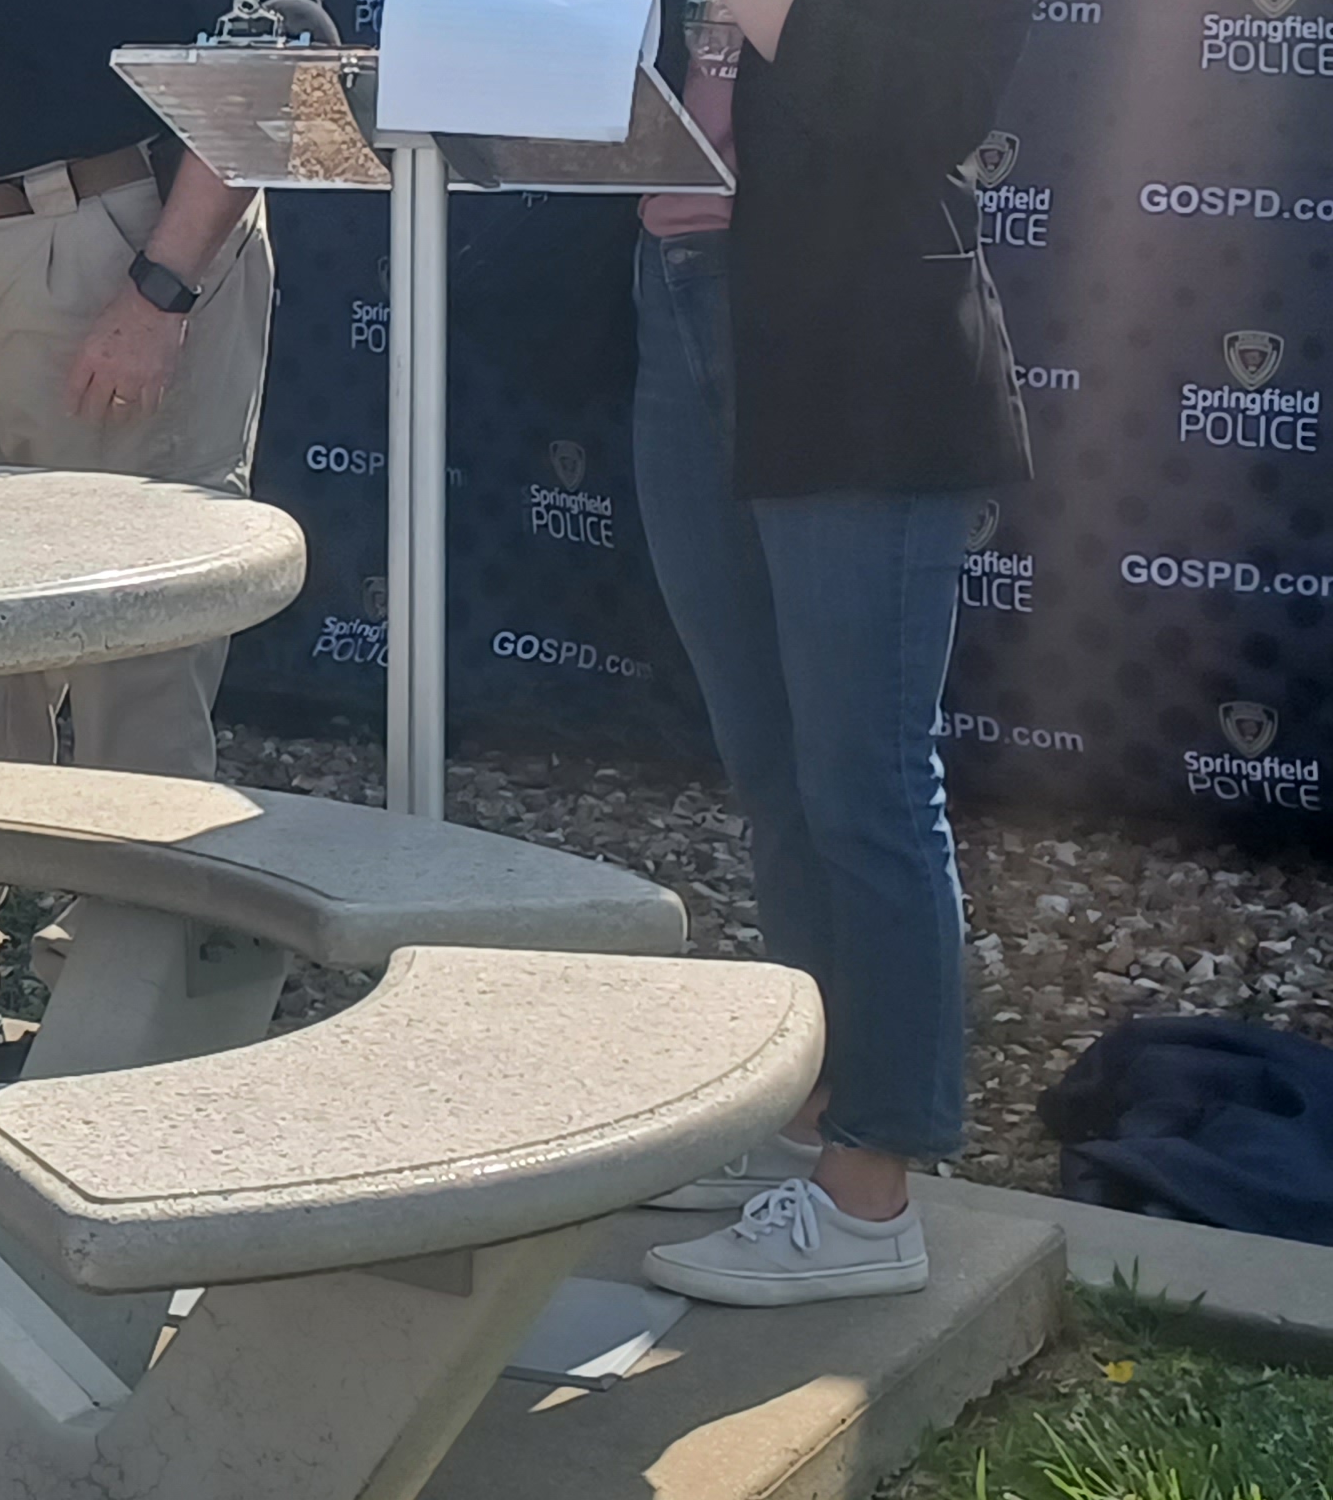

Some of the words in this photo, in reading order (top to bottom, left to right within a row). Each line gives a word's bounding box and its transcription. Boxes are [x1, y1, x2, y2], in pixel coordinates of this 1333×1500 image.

[975, 186, 1051, 213] ngfield
[1140, 183, 1333, 222] GOSPD.co
[1181, 383, 1320, 416] Springfield
[1180, 409, 1318, 452] POLICE
[530, 484, 612, 517] Springfield
[532, 506, 615, 549] POLICE
[964, 550, 1033, 578] gfield
[962, 574, 1033, 613] LICE
[322, 616, 389, 643] Springf
[312, 635, 389, 668] POLIC
[493, 631, 653, 679] GOSPD.com
[941, 711, 1084, 753] PD.com
[1183, 750, 1319, 782] Springfield
